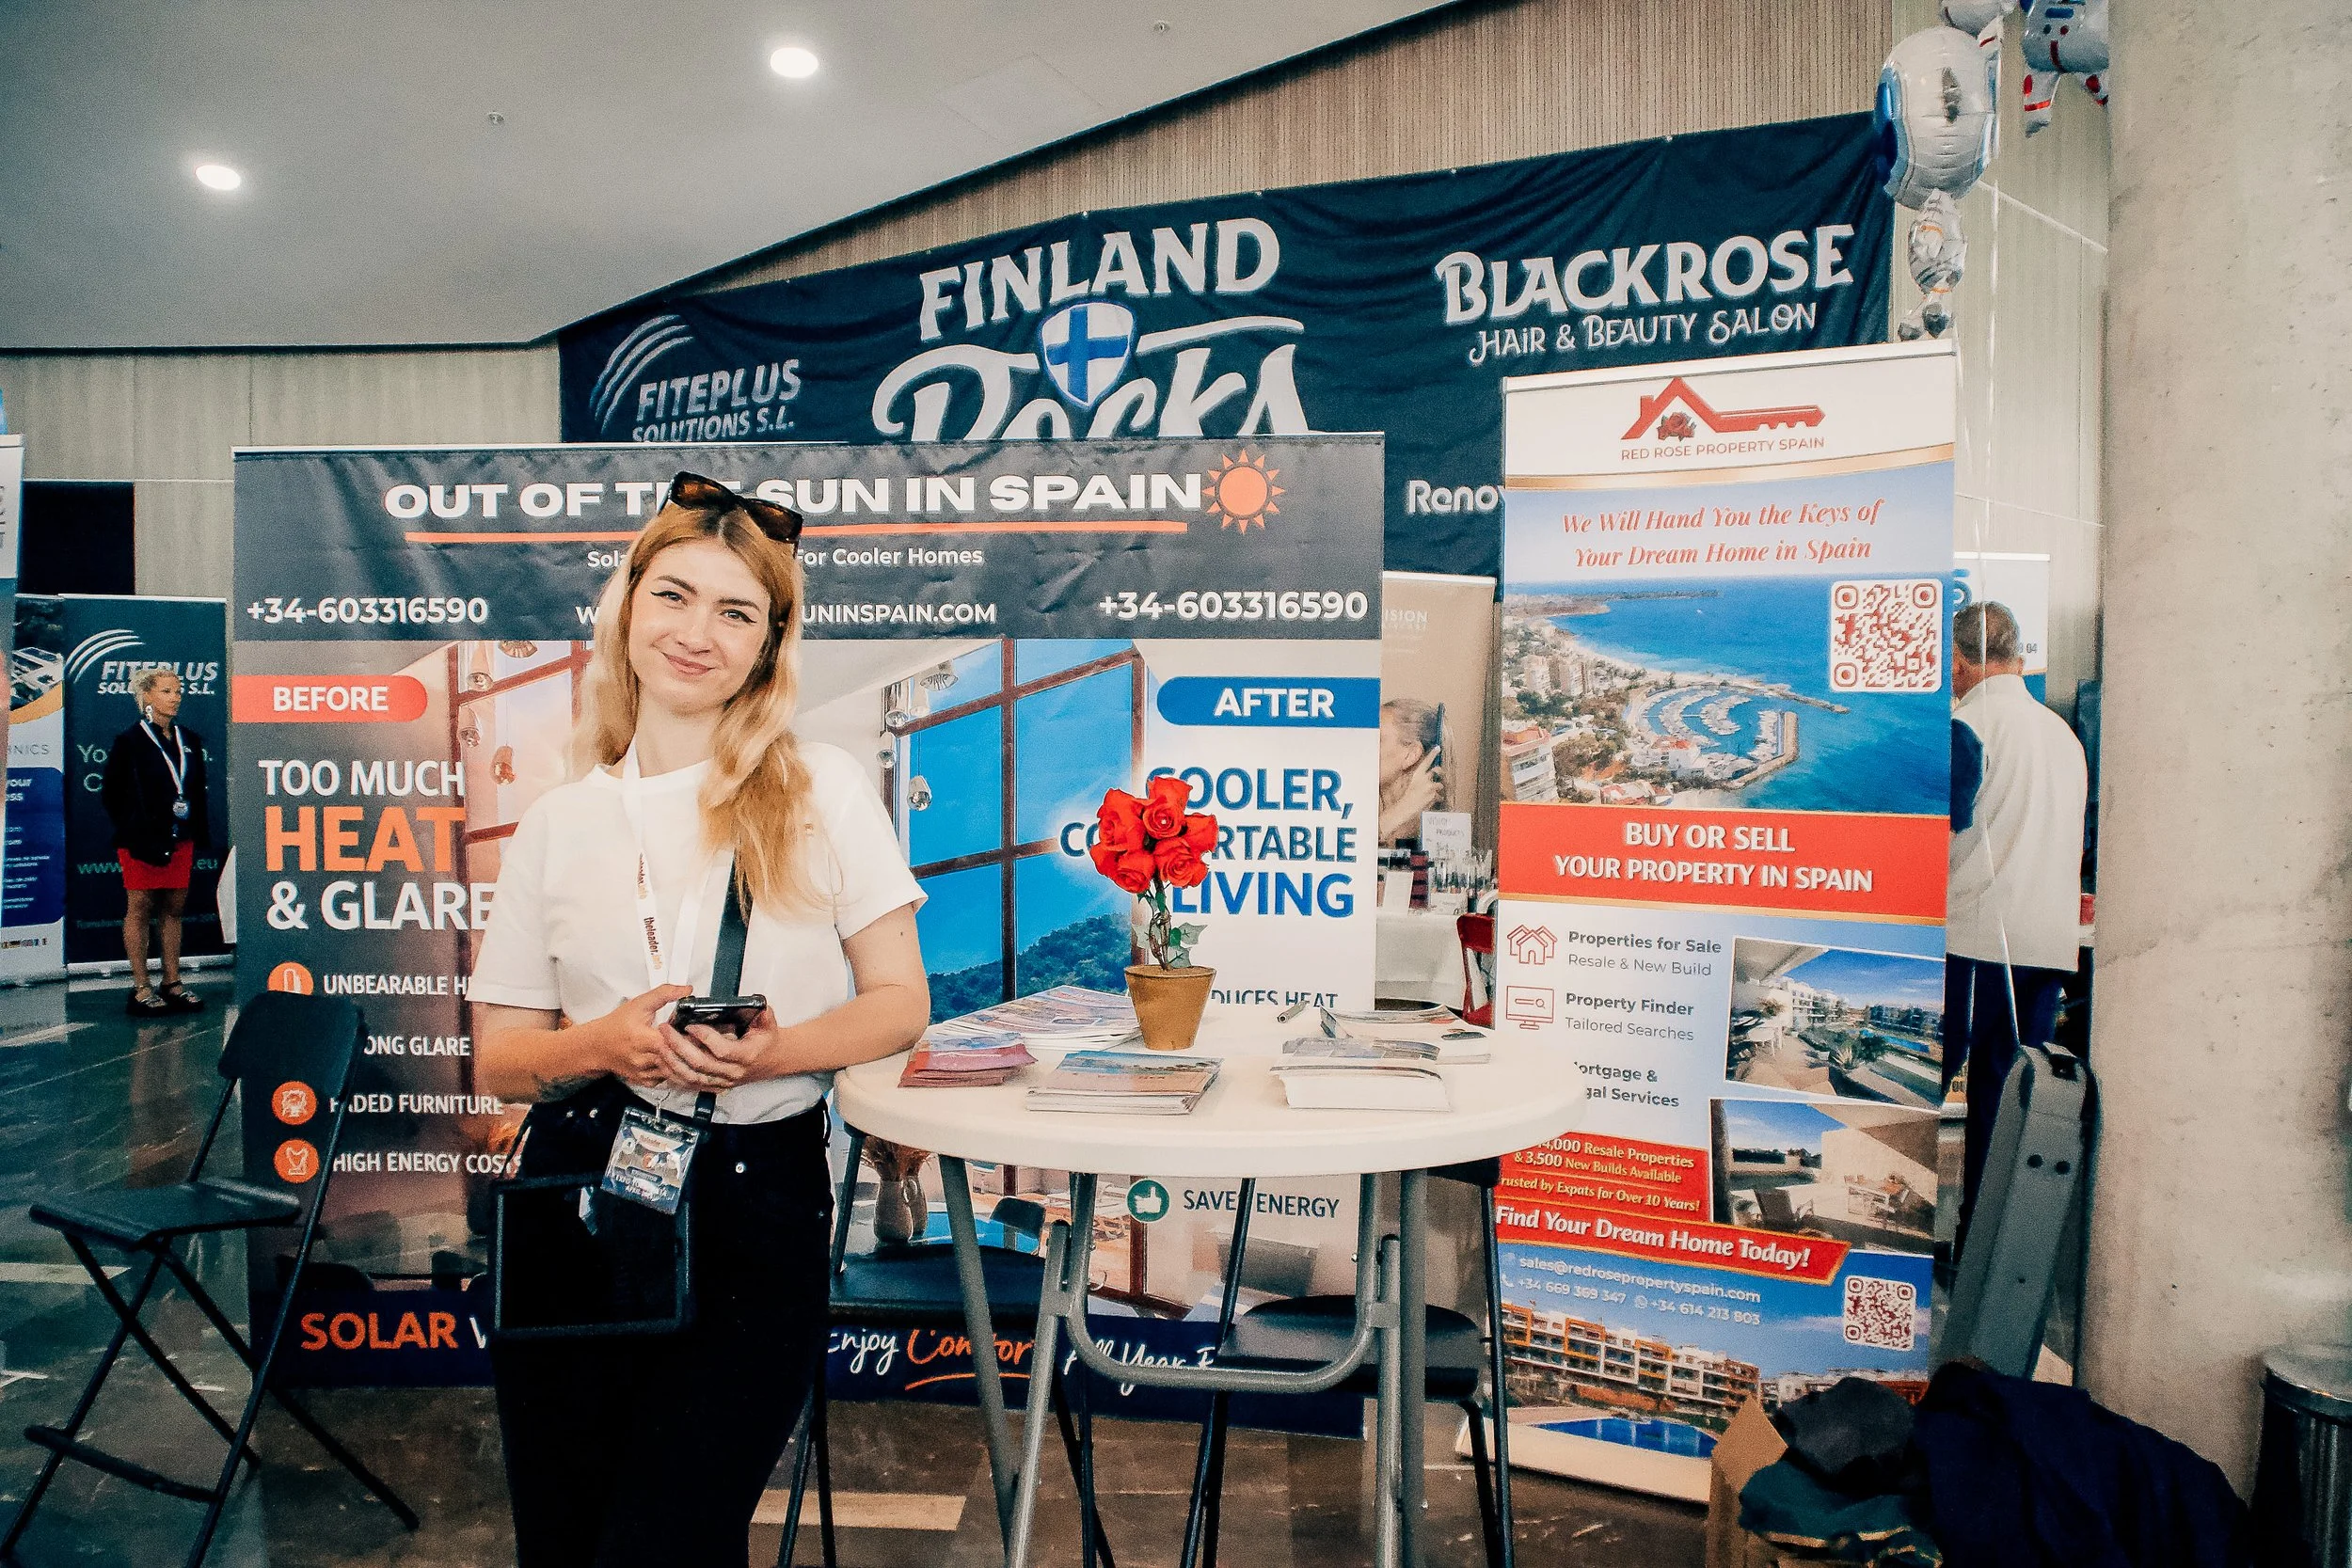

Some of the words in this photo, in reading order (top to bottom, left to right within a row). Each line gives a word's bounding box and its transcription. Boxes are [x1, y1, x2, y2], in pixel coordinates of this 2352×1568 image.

[919, 217, 1280, 342] FINLAND
[1435, 224, 1854, 325] BLACKROSE
[1556, 324, 1576, 349] &
[1583, 313, 1697, 349] BEAUTY
[1708, 303, 1817, 344] SALON
[637, 358, 802, 421] FITEPLUS
[632, 409, 751, 442] SOLUTIONS
[757, 405, 794, 432] S.L.
[1622, 447, 1649, 461] RED
[1654, 445, 1692, 457] ROSE
[1697, 439, 1774, 455] PROPERTY
[1779, 436, 1825, 451] SPAIN
[384, 483, 508, 518] OUT
[519, 483, 601, 516] OF
[756, 477, 890, 514] SUN
[906, 476, 976, 513] IN
[990, 473, 1201, 511] SPAIN
[1563, 515, 1592, 533] We
[1599, 510, 1640, 531] Will
[1645, 508, 1705, 529] Hand
[1712, 505, 1751, 528] You
[1758, 503, 1791, 527] the
[1799, 503, 1850, 527] Keys
[1857, 498, 1885, 527] of
[832, 547, 902, 566] Cooler
[908, 547, 984, 564] Homes
[1575, 547, 1623, 567] Your
[1629, 545, 1698, 565] Dream
[1706, 542, 1769, 562] Home
[1775, 540, 1798, 561] in
[1804, 537, 1871, 561] Spain
[247, 597, 488, 625] +34-603316590
[1100, 591, 1369, 622] +34-603316590
[1385, 610, 1428, 623] ISION
[273, 686, 389, 712] BEFORE
[1214, 688, 1335, 718] AFTER
[259, 760, 341, 796] TOO
[349, 760, 467, 796] MUCH
[264, 805, 467, 872] HEAT
[1624, 821, 1680, 847] BUY
[1685, 824, 1725, 849] OR
[1733, 826, 1795, 853] SELL
[1555, 854, 1621, 879] YOUR
[1627, 859, 1756, 887] PROPERTY
[1761, 864, 1788, 888] IN
[1794, 866, 1874, 893] SPAIN
[266, 880, 309, 930] &
[320, 880, 497, 930] GLARE
[1171, 871, 1355, 918] LIVING
[1568, 930, 1653, 949] Properties
[1657, 937, 1680, 950] for
[1686, 939, 1722, 954] Sale
[1568, 954, 1616, 968] Resale
[1620, 958, 1629, 970] &
[1634, 958, 1667, 973] New
[1672, 961, 1711, 976] Build
[323, 974, 449, 996] UNBEARABLE
[1565, 992, 1636, 1013] Property
[1641, 999, 1693, 1016] Finder
[1565, 1017, 1623, 1034] Tailored
[1627, 1022, 1693, 1041] Searches
[363, 1036, 405, 1056] ONG
[409, 1037, 470, 1056] GLARE
[1574, 1061, 1642, 1083] ortgage
[1646, 1069, 1658, 1083] &
[329, 1094, 393, 1114] FDED
[399, 1093, 504, 1116] FURNITURE
[1585, 1086, 1607, 1100] gal
[1611, 1087, 1679, 1107] Services
[332, 1152, 381, 1173] HIGH
[387, 1152, 461, 1173] ENERGY
[1514, 1152, 1523, 1164] &
[1526, 1151, 1563, 1167] 3,500
[1565, 1158, 1591, 1170] New
[1593, 1161, 1628, 1176] Builds
[1629, 1168, 1682, 1184] Available
[1584, 1142, 1625, 1160] Resale
[1628, 1148, 1694, 1168] Properties
[1256, 1193, 1340, 1218] ENERGY
[1500, 1177, 1538, 1190] rusted
[1540, 1178, 1554, 1194] by
[1557, 1181, 1596, 1197] Expats
[1597, 1184, 1614, 1200] for
[1615, 1190, 1644, 1204] Over
[1645, 1195, 1661, 1207] 10
[1663, 1196, 1700, 1212] Years!
[1495, 1205, 1541, 1229] Find
[1545, 1211, 1592, 1235] Your
[1596, 1218, 1665, 1248] Dream
[1670, 1230, 1736, 1257] Home
[1738, 1238, 1812, 1271] Today!
[1518, 1276, 1542, 1290] +34
[1546, 1281, 1570, 1295] 669
[1650, 1299, 1677, 1313] +34
[1519, 1256, 1761, 1304] sales@redrosepropertyspain.com
[300, 1311, 459, 1351] SOLAR
